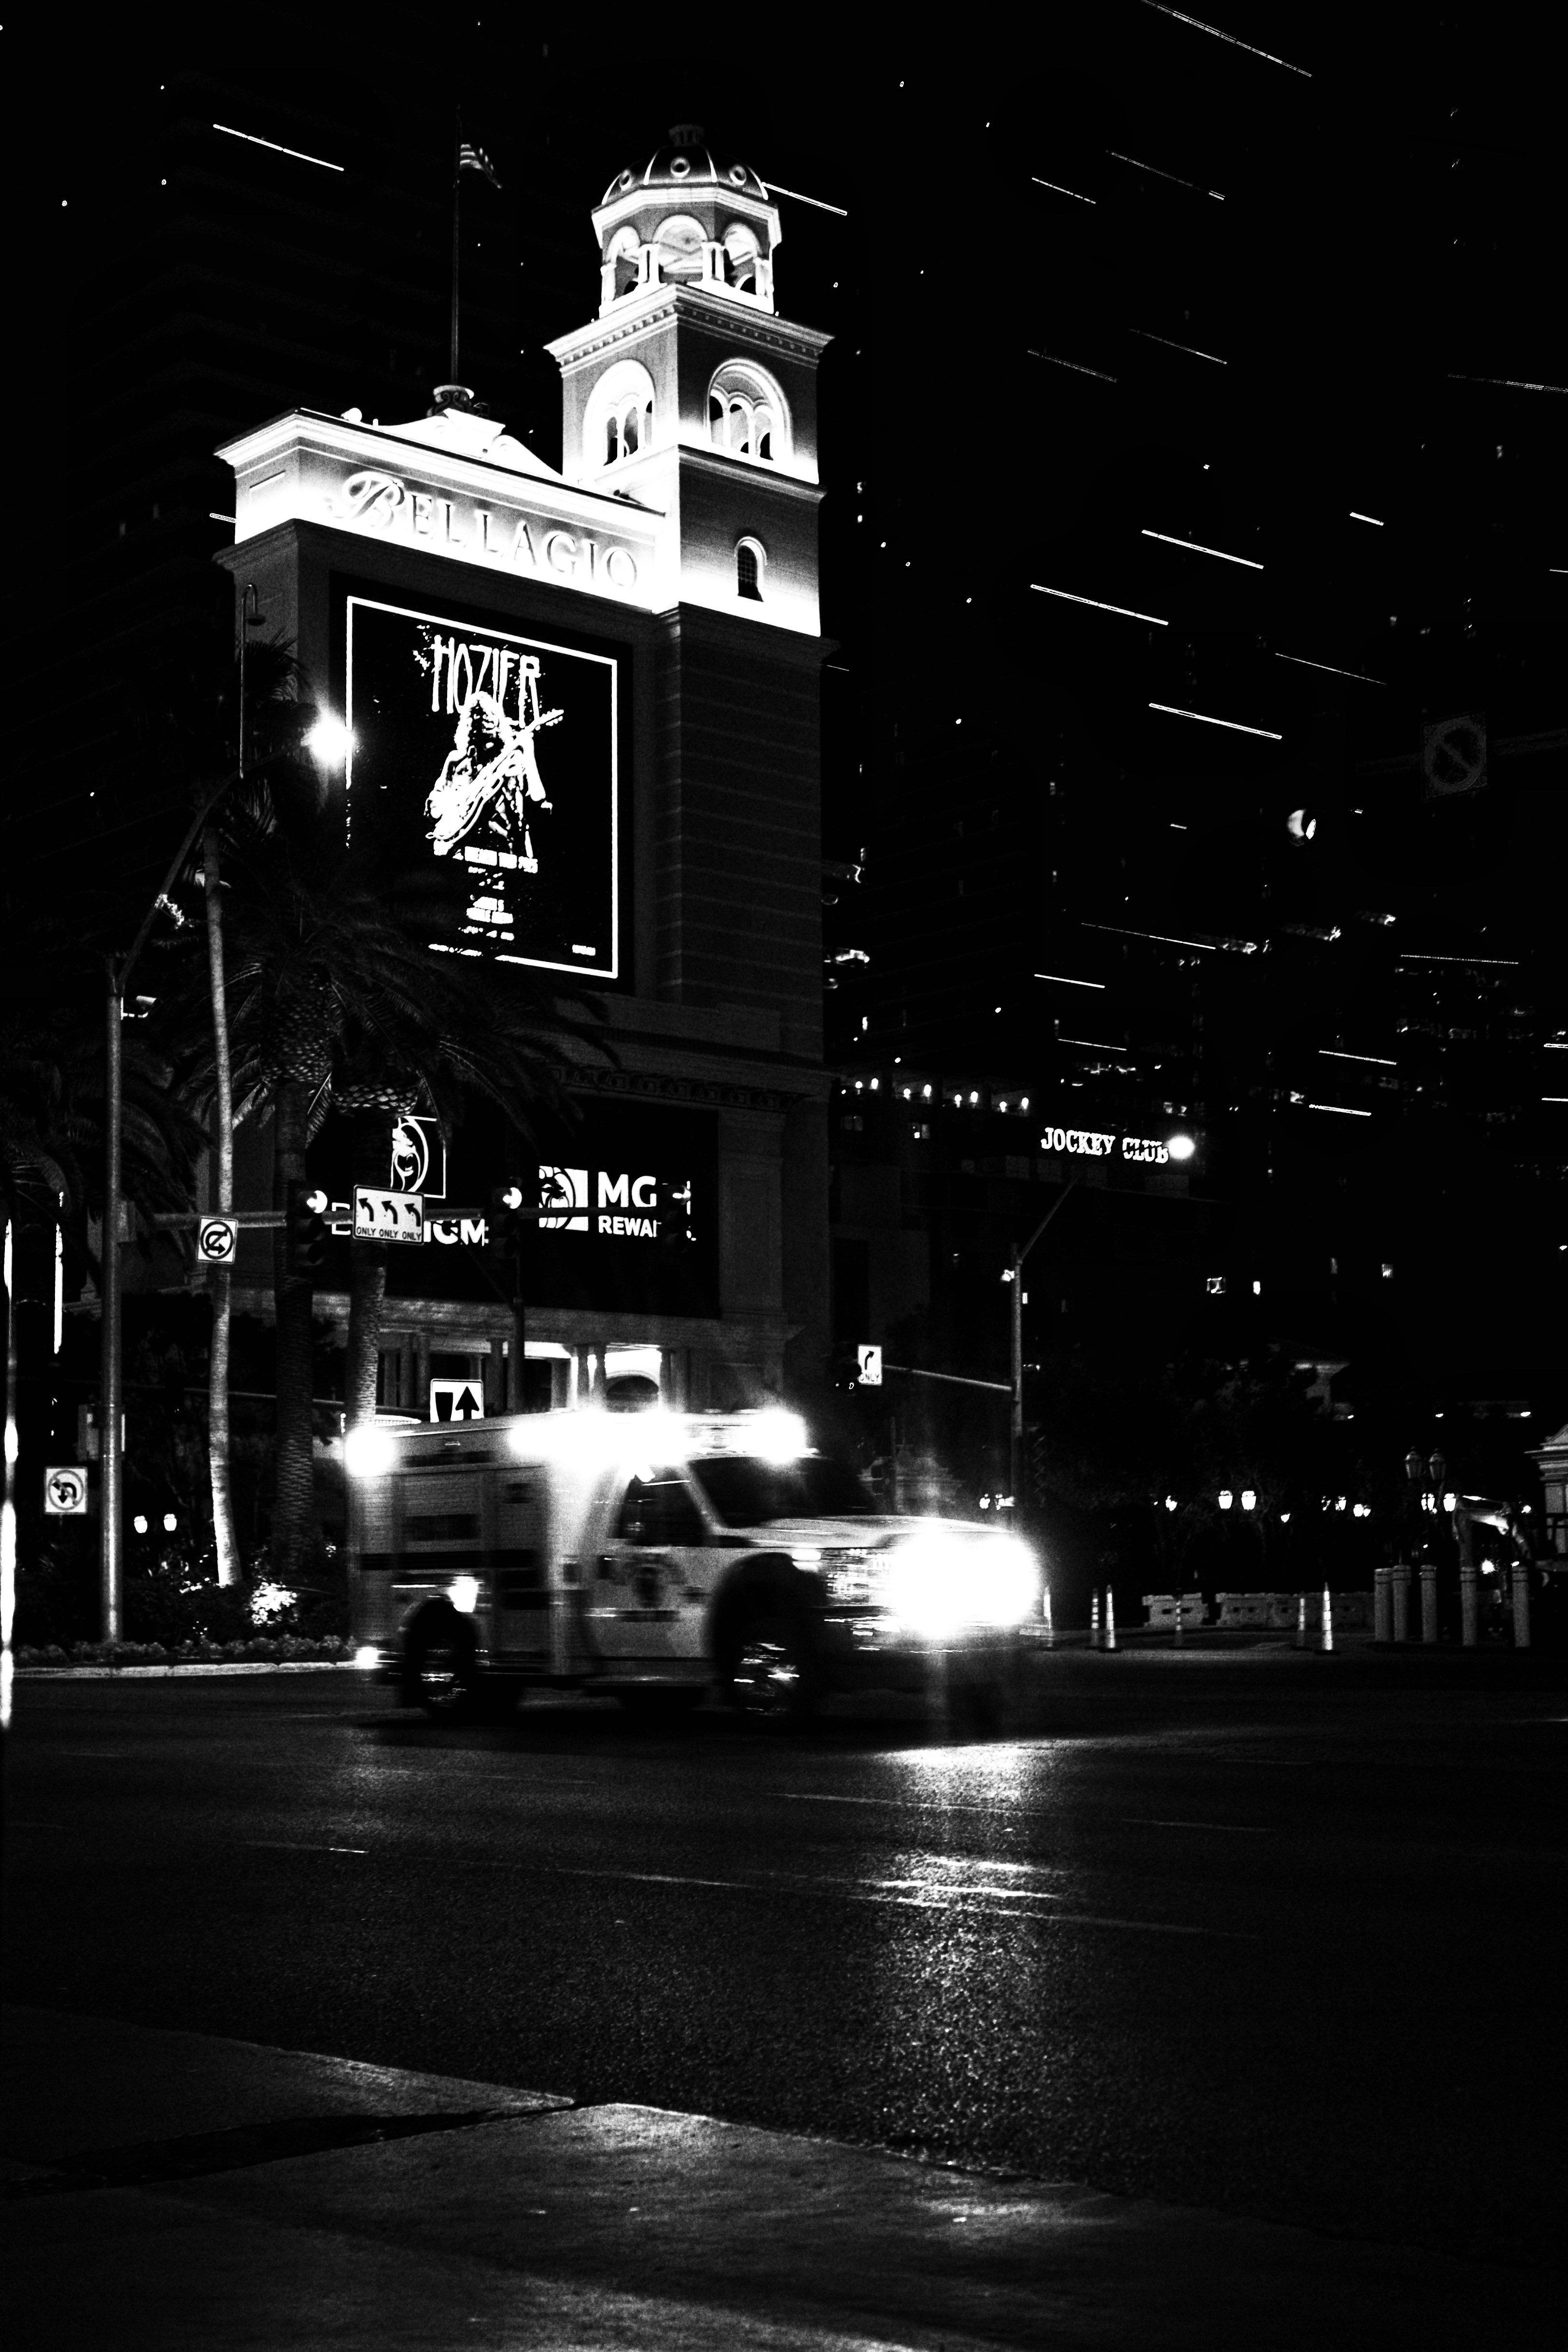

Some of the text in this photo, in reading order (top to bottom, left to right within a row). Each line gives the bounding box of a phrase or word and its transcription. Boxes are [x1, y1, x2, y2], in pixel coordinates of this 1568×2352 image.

[323, 471, 638, 588] BELLAGIO
[432, 634, 541, 728] HOZIER
[1041, 1127, 1169, 1163] JOCKEY CLUB
[598, 1171, 691, 1215] MG
[356, 1226, 422, 1240] ONLY ONLY ONLY
